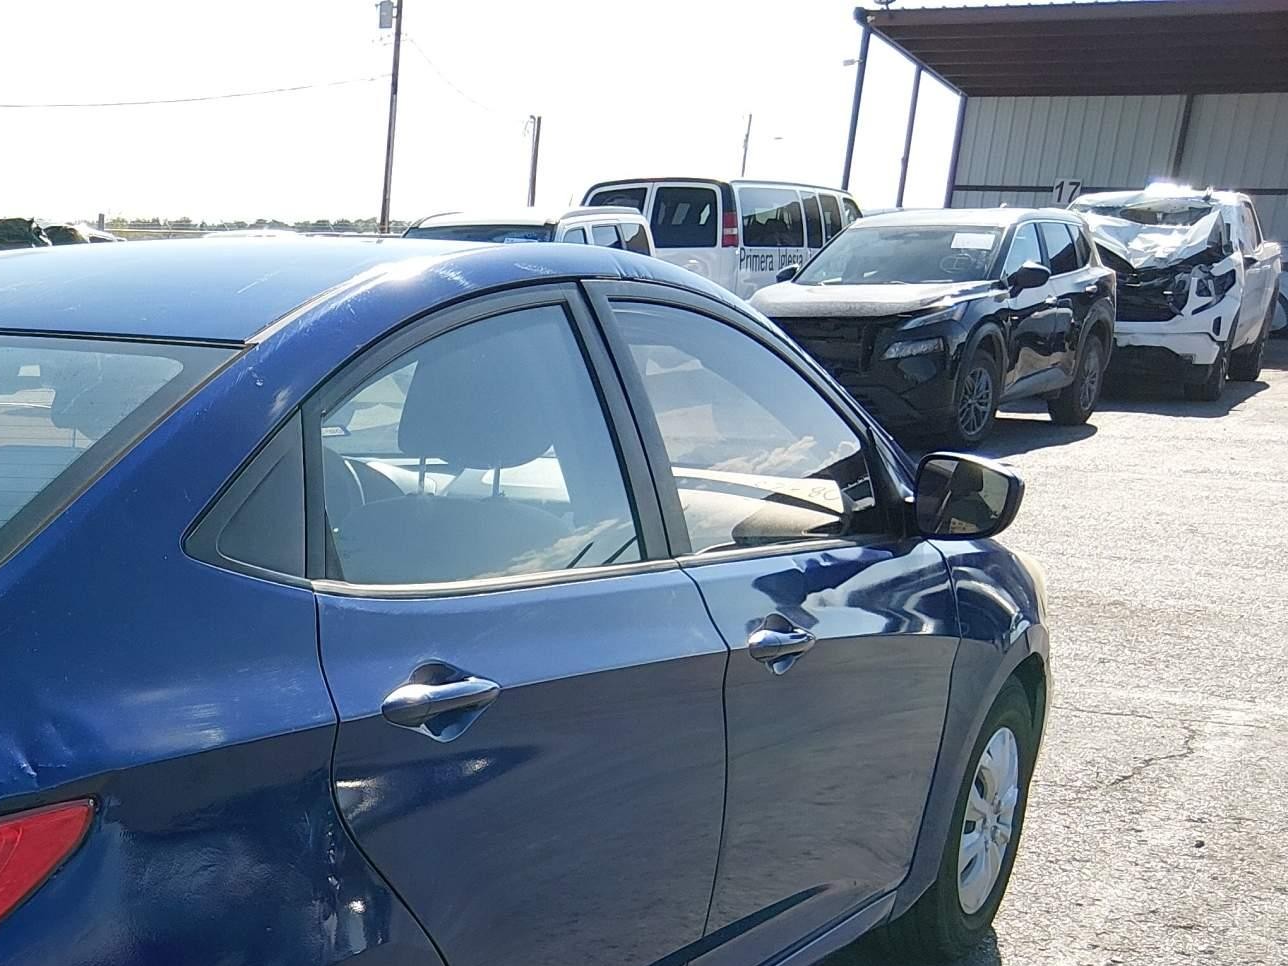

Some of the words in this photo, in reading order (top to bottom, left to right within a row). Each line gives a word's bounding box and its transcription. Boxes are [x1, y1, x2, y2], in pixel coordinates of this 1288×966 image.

[1055, 181, 1081, 203] 17
[739, 247, 773, 272] Primera
[778, 248, 803, 270] Iglesia
